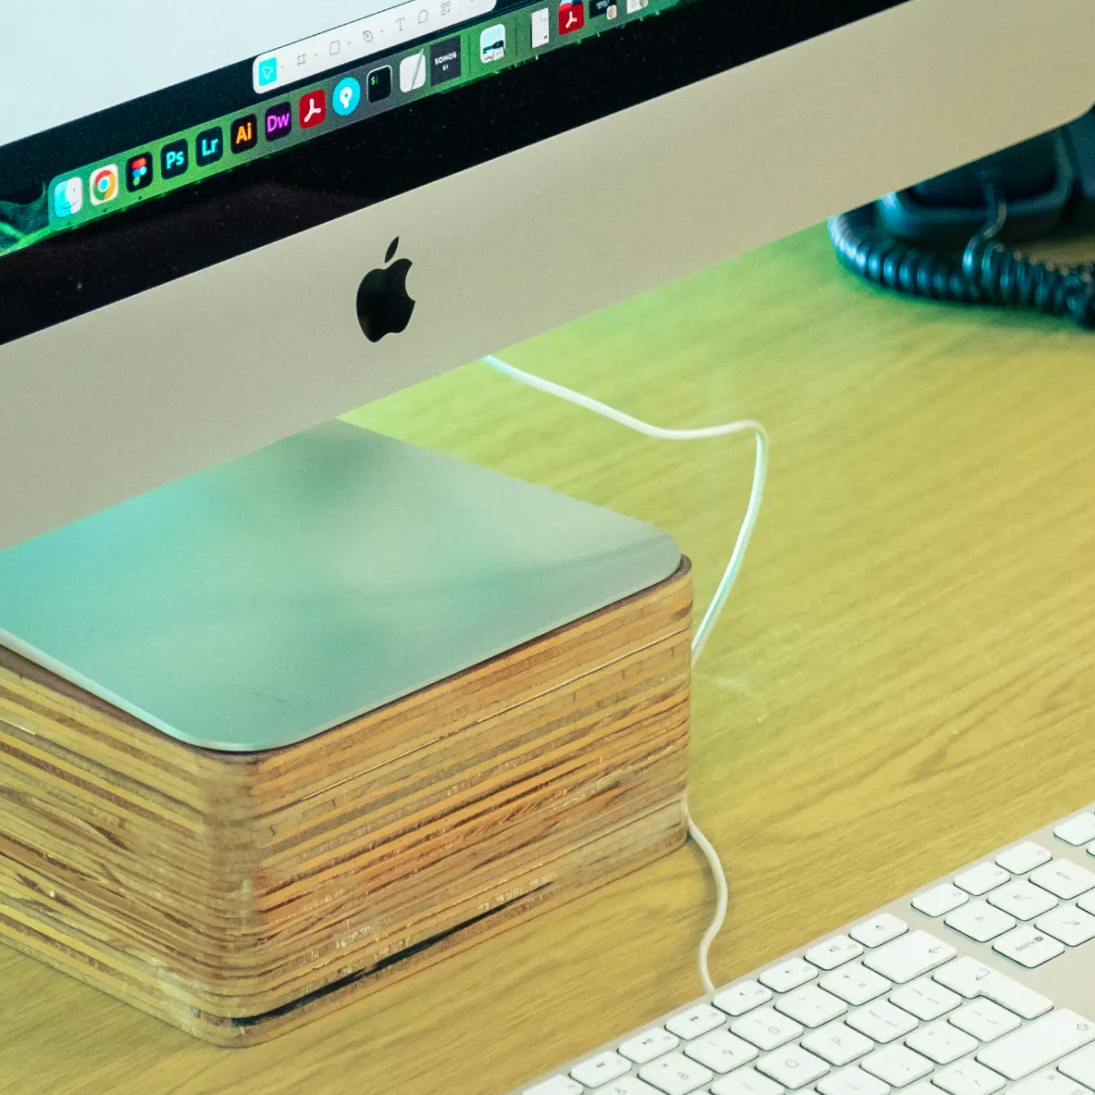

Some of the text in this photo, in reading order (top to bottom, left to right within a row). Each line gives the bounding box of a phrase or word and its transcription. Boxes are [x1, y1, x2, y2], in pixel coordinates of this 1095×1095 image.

[434, 51, 457, 66] SONOS
[166, 111, 291, 169] Ps Lr Ai Dw
